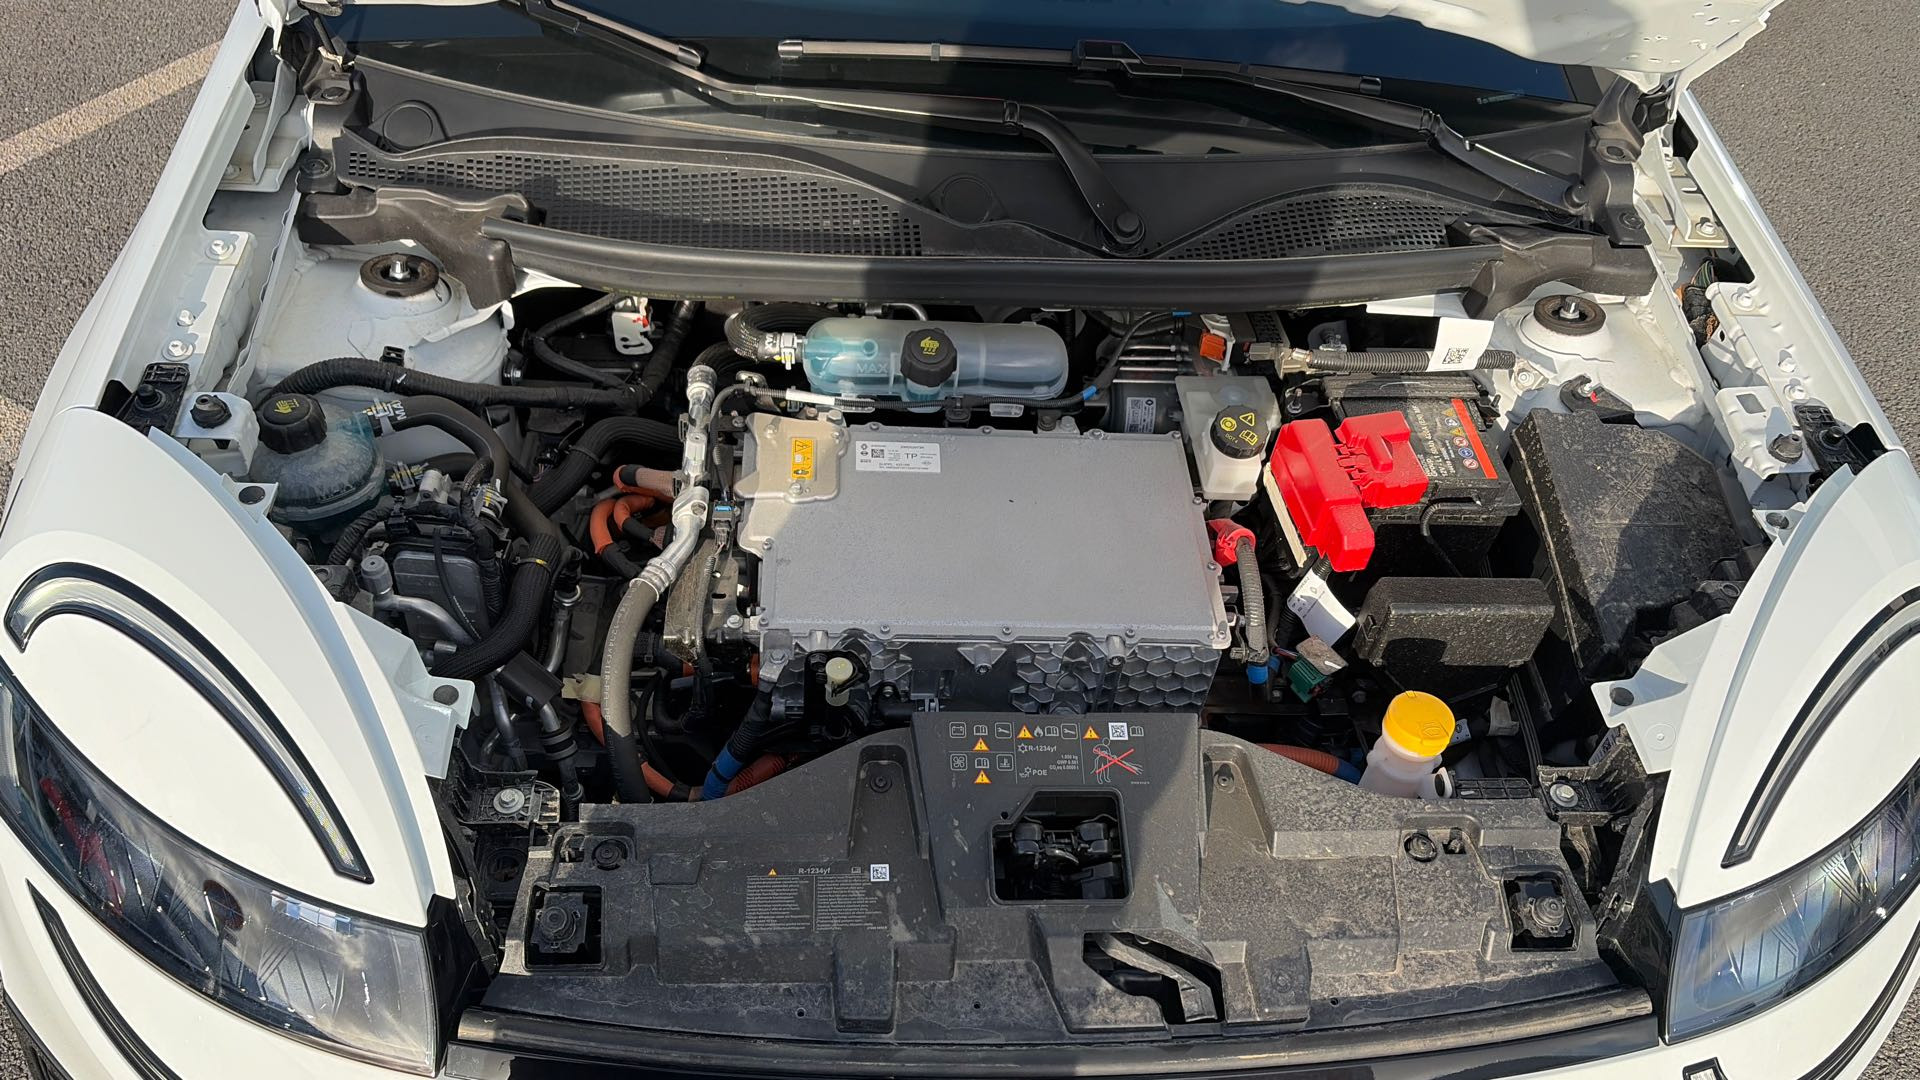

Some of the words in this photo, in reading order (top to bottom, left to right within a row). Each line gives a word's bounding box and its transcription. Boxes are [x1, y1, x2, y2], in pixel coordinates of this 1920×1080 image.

[856, 363, 888, 373] MAX
[1225, 433, 1235, 441] DOT
[1028, 745, 1057, 753] R-1234yf
[798, 867, 831, 875] R-1234yf
